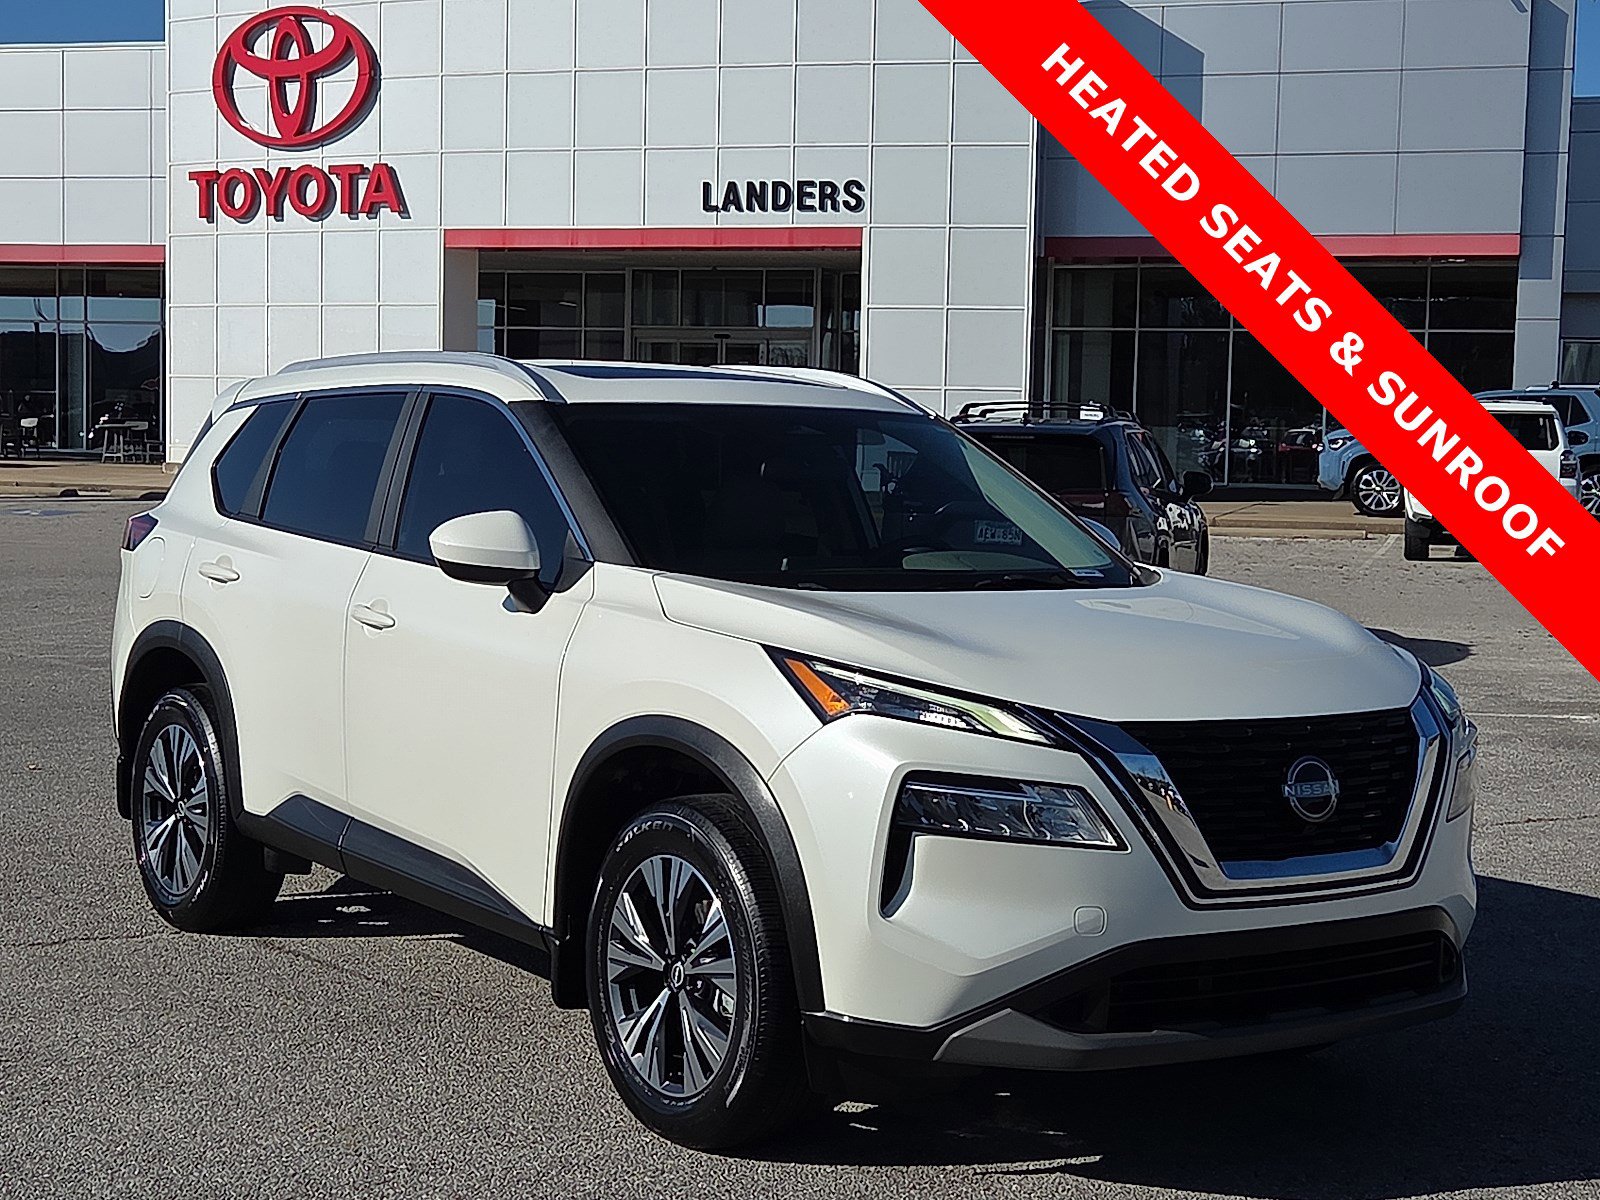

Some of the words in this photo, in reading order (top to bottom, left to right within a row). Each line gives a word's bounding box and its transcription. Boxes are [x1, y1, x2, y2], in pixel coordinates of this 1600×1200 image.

[188, 163, 405, 222] TOYOTA
[702, 179, 867, 214] LANDERS
[1282, 780, 1340, 798] NISSAN
